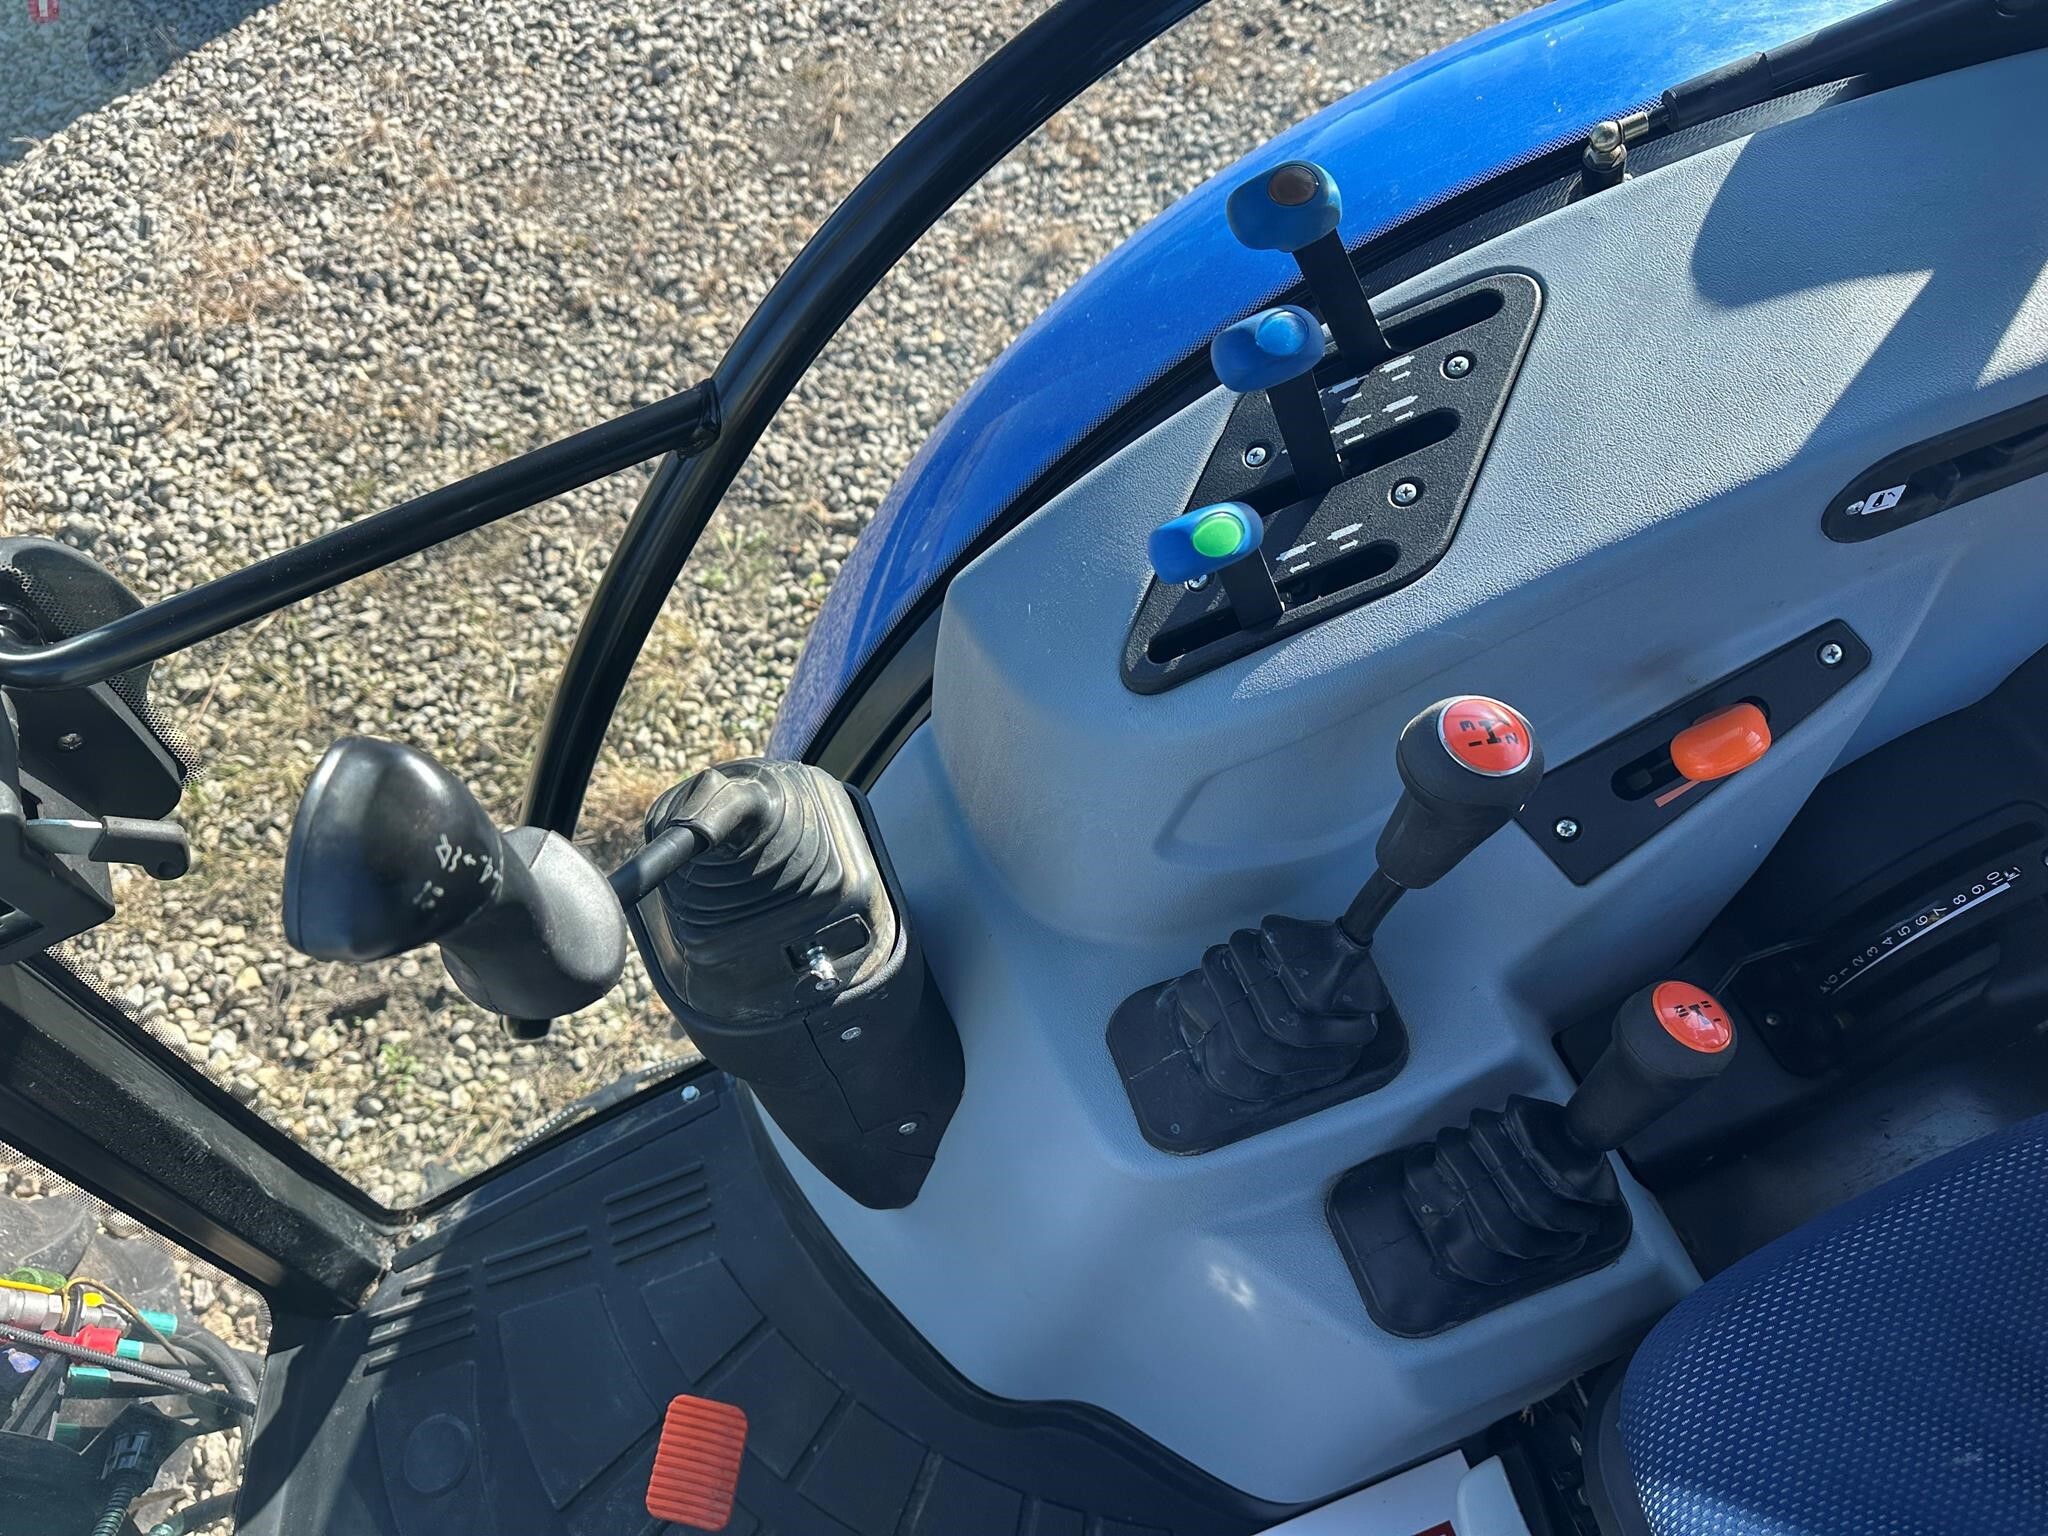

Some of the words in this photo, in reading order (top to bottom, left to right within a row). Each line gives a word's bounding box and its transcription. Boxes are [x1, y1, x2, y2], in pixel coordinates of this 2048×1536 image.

[1840, 967, 1848, 976] 1
[1852, 955, 1864, 967] 2
[1866, 946, 1878, 957] 3
[1881, 936, 1893, 945] 4
[1897, 925, 1910, 937] 5
[1915, 915, 1928, 926] 6
[1932, 907, 1948, 917] 7
[1952, 894, 1967, 905] 8
[1971, 884, 1985, 895] 9
[1986, 871, 2004, 886] 10
